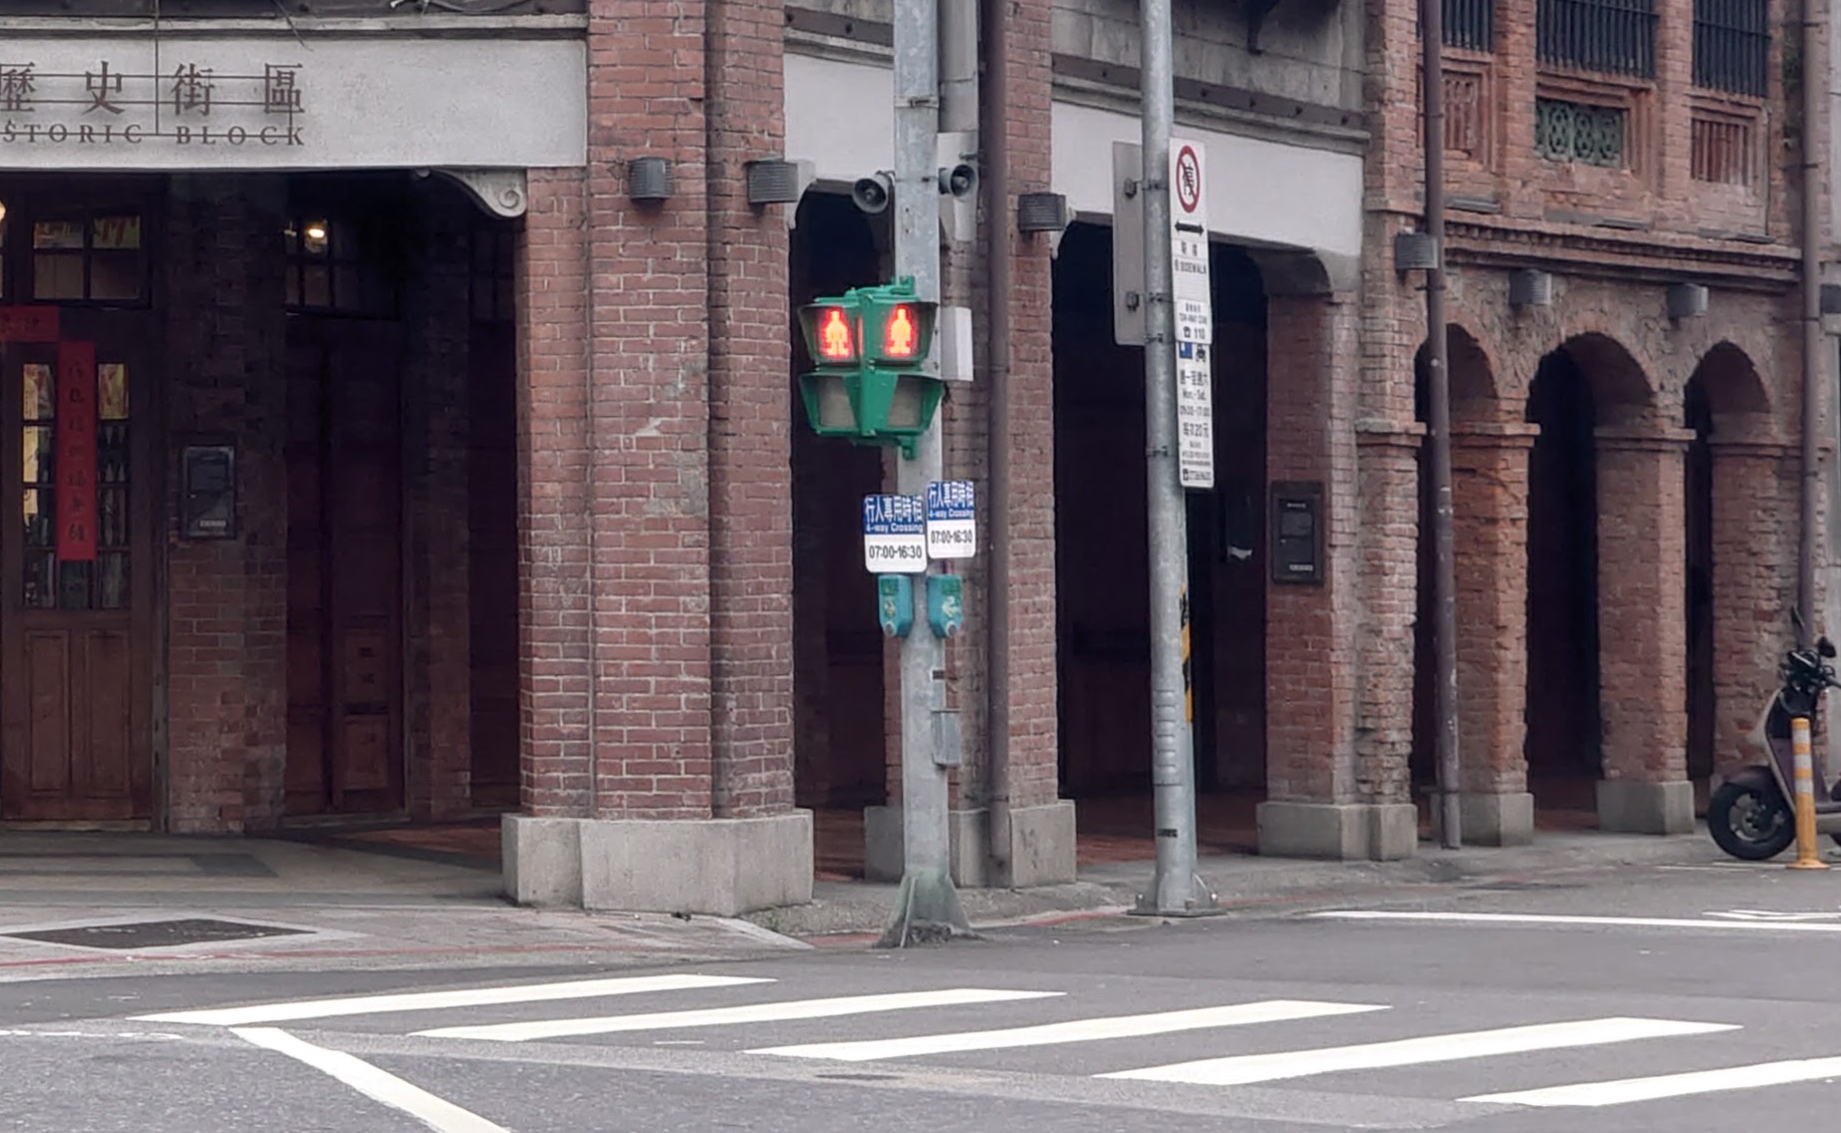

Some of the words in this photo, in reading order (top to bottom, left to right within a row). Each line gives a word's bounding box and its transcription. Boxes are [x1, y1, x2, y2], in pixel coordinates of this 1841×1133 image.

[175, 125, 305, 146] BLOCK
[866, 523, 888, 533] 4-way
[890, 523, 923, 534] Crossing
[931, 529, 973, 544] 07:00-16:30
[869, 545, 922, 559] 07:00-16:30
